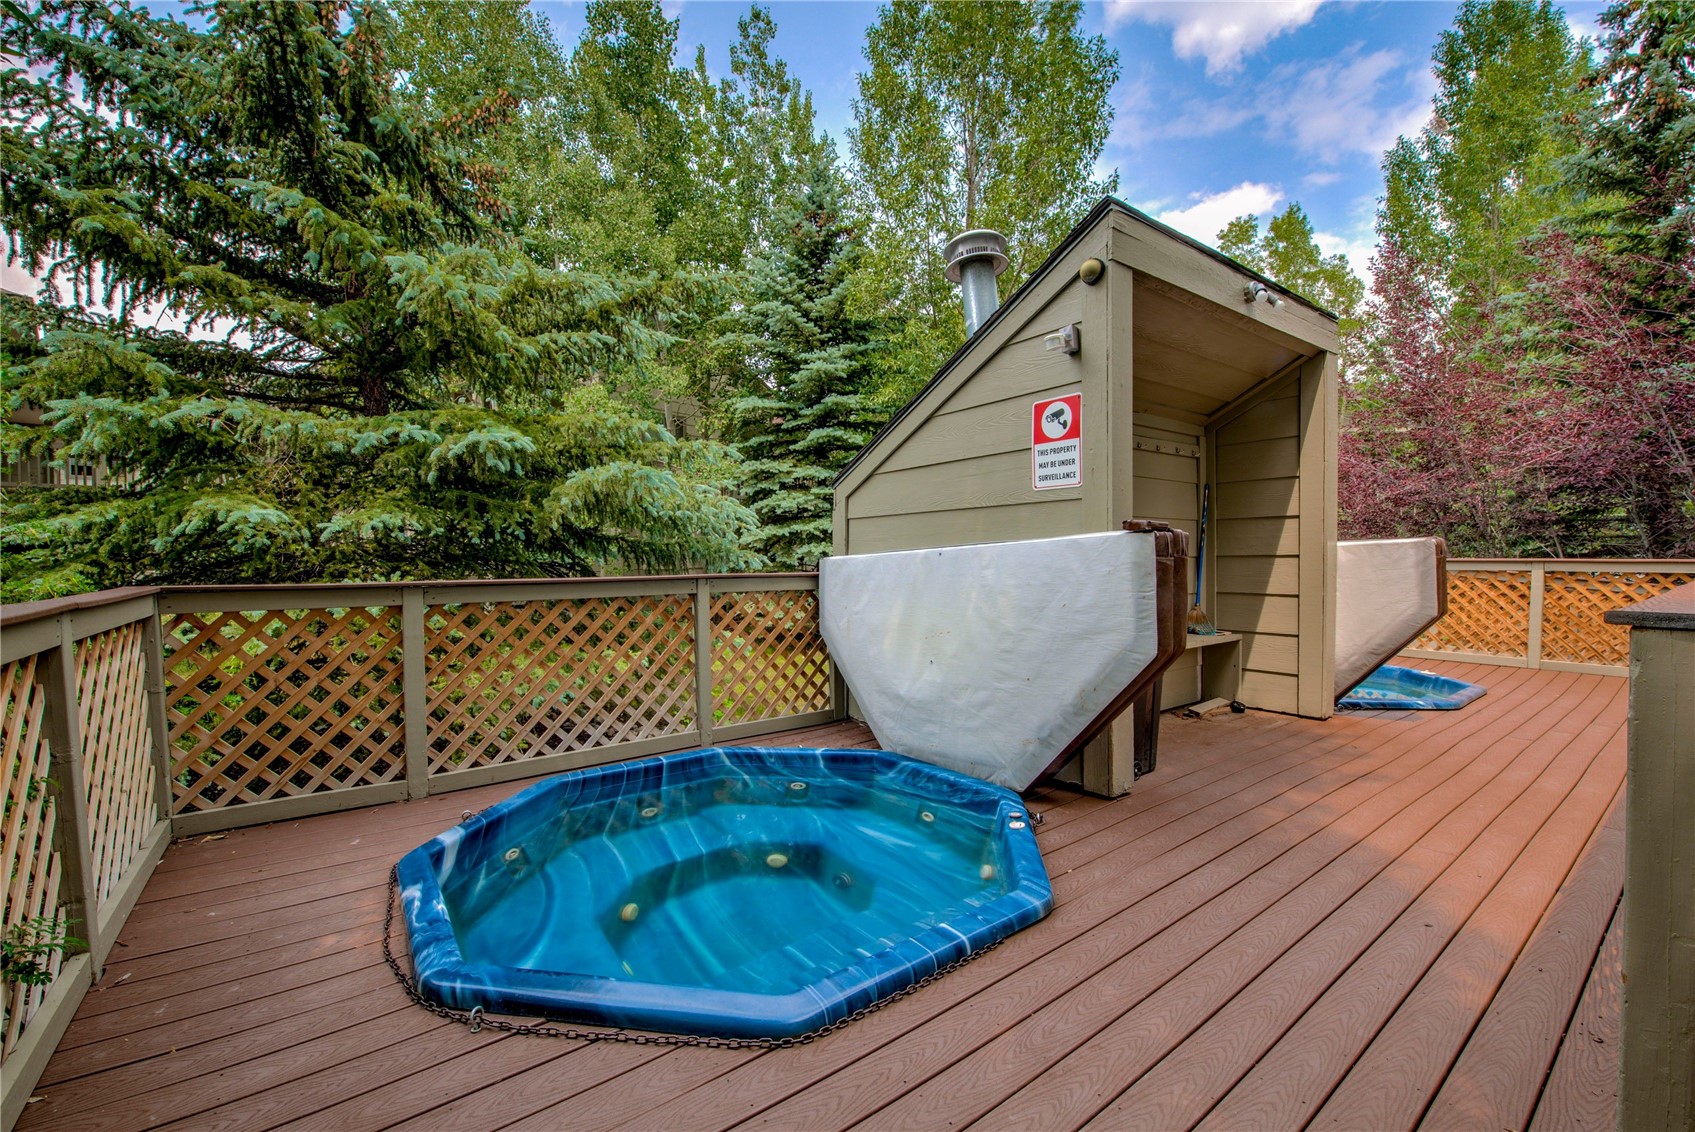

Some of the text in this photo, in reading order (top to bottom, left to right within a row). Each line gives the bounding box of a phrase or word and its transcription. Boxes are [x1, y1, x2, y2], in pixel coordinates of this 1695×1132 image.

[1050, 445, 1077, 455] PROPERTY
[1058, 458, 1076, 467] UNDER
[1038, 471, 1076, 482] SURVEILLANCE
